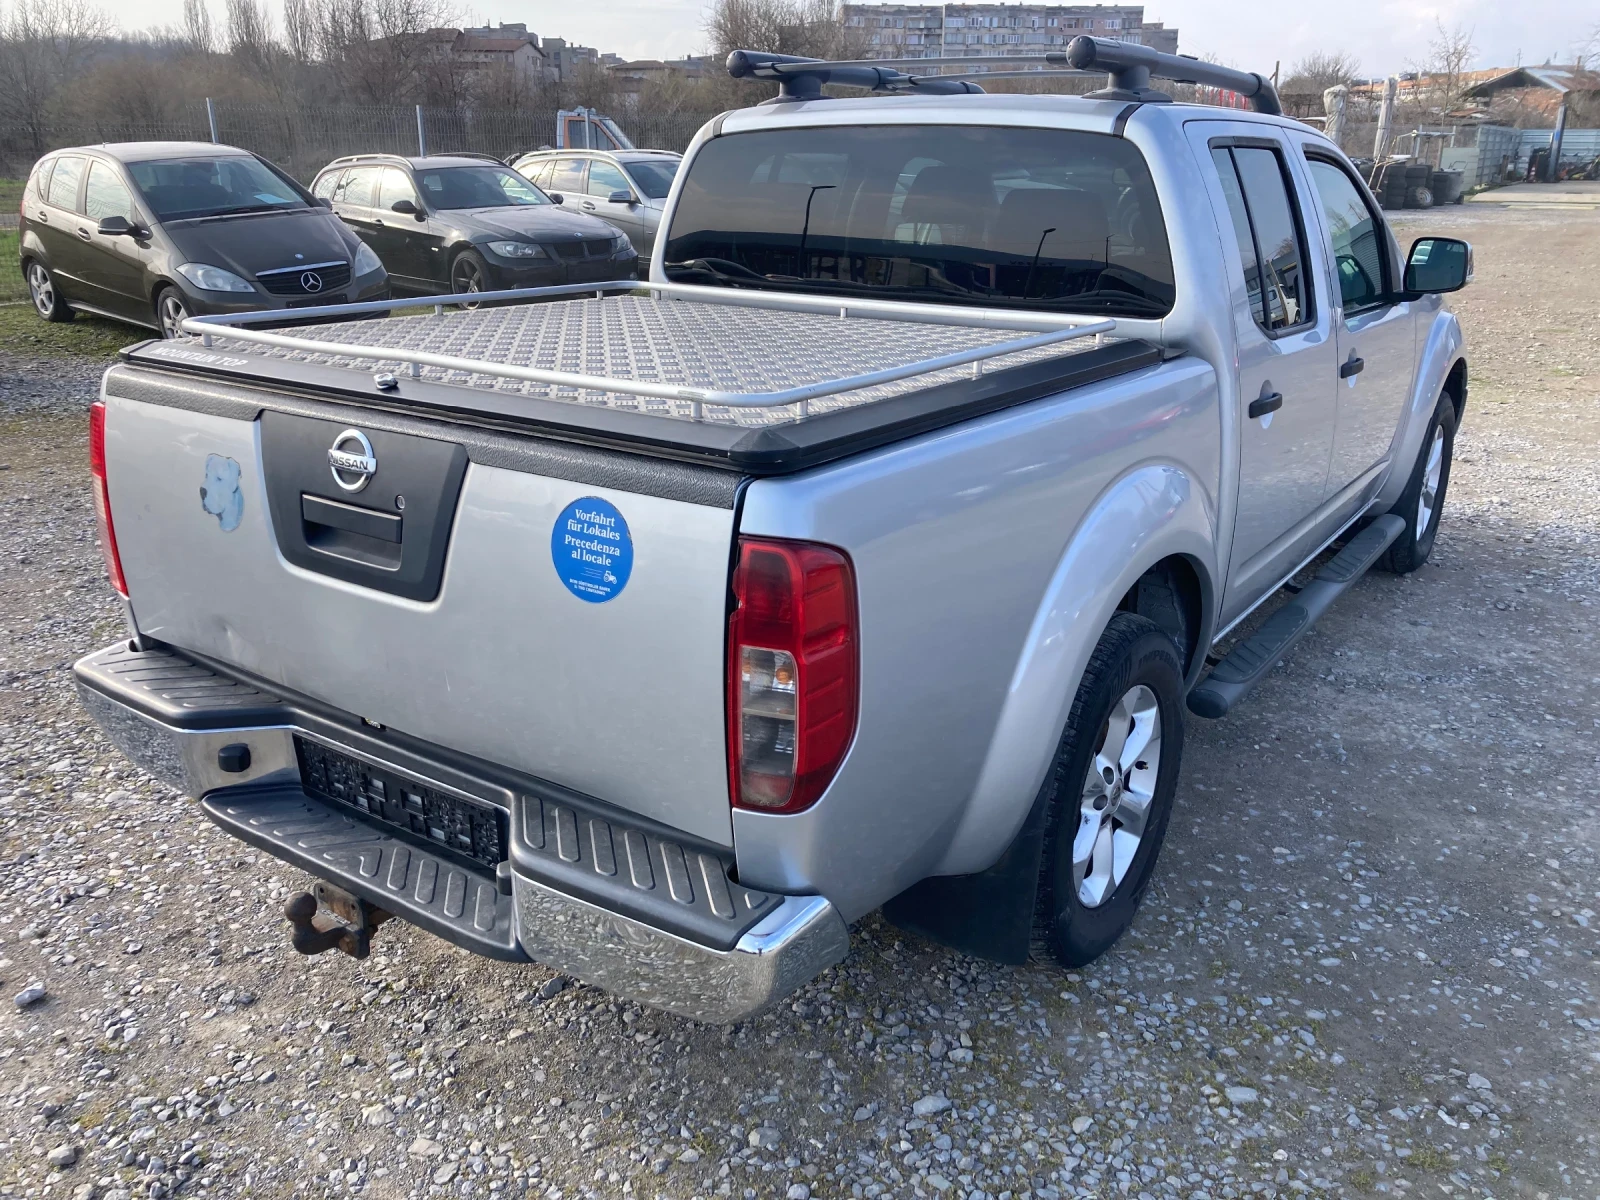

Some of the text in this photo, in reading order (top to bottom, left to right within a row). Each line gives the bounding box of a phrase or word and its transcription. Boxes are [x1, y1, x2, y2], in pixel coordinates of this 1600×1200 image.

[150, 347, 249, 367] MOUNTAIN TOP
[329, 455, 368, 470] NISSAN
[575, 509, 615, 526] Vorfahrt
[567, 519, 620, 540] für Lokales
[564, 534, 620, 556] Precedenza
[571, 549, 611, 566] al locale
